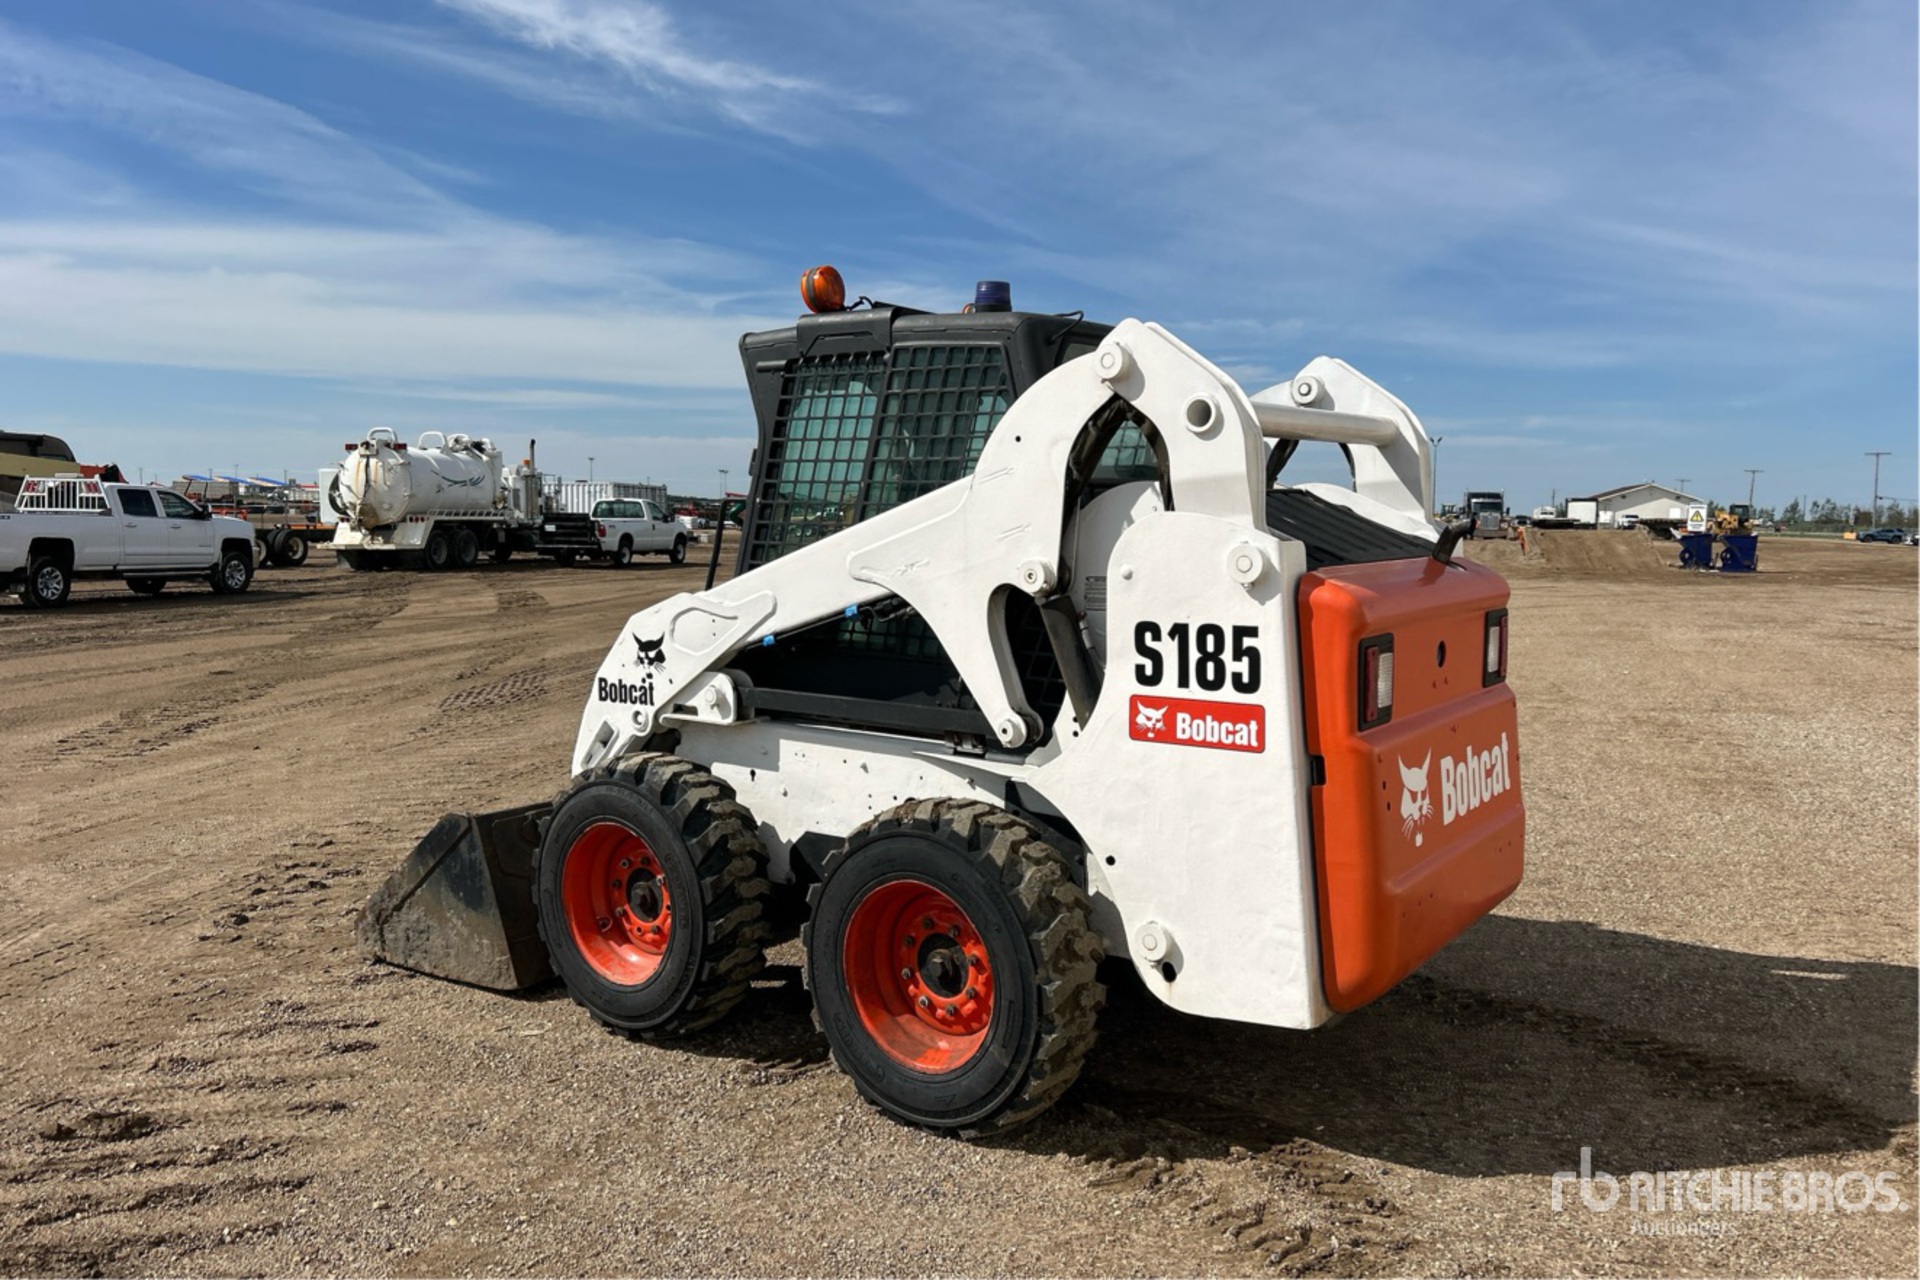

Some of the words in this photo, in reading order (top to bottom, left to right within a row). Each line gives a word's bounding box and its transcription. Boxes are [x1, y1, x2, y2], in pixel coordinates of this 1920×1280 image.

[1134, 620, 1261, 694] S185
[598, 677, 655, 706] Bobcat
[1176, 713, 1259, 747] Bobcat
[1440, 732, 1511, 825] Bobcat
